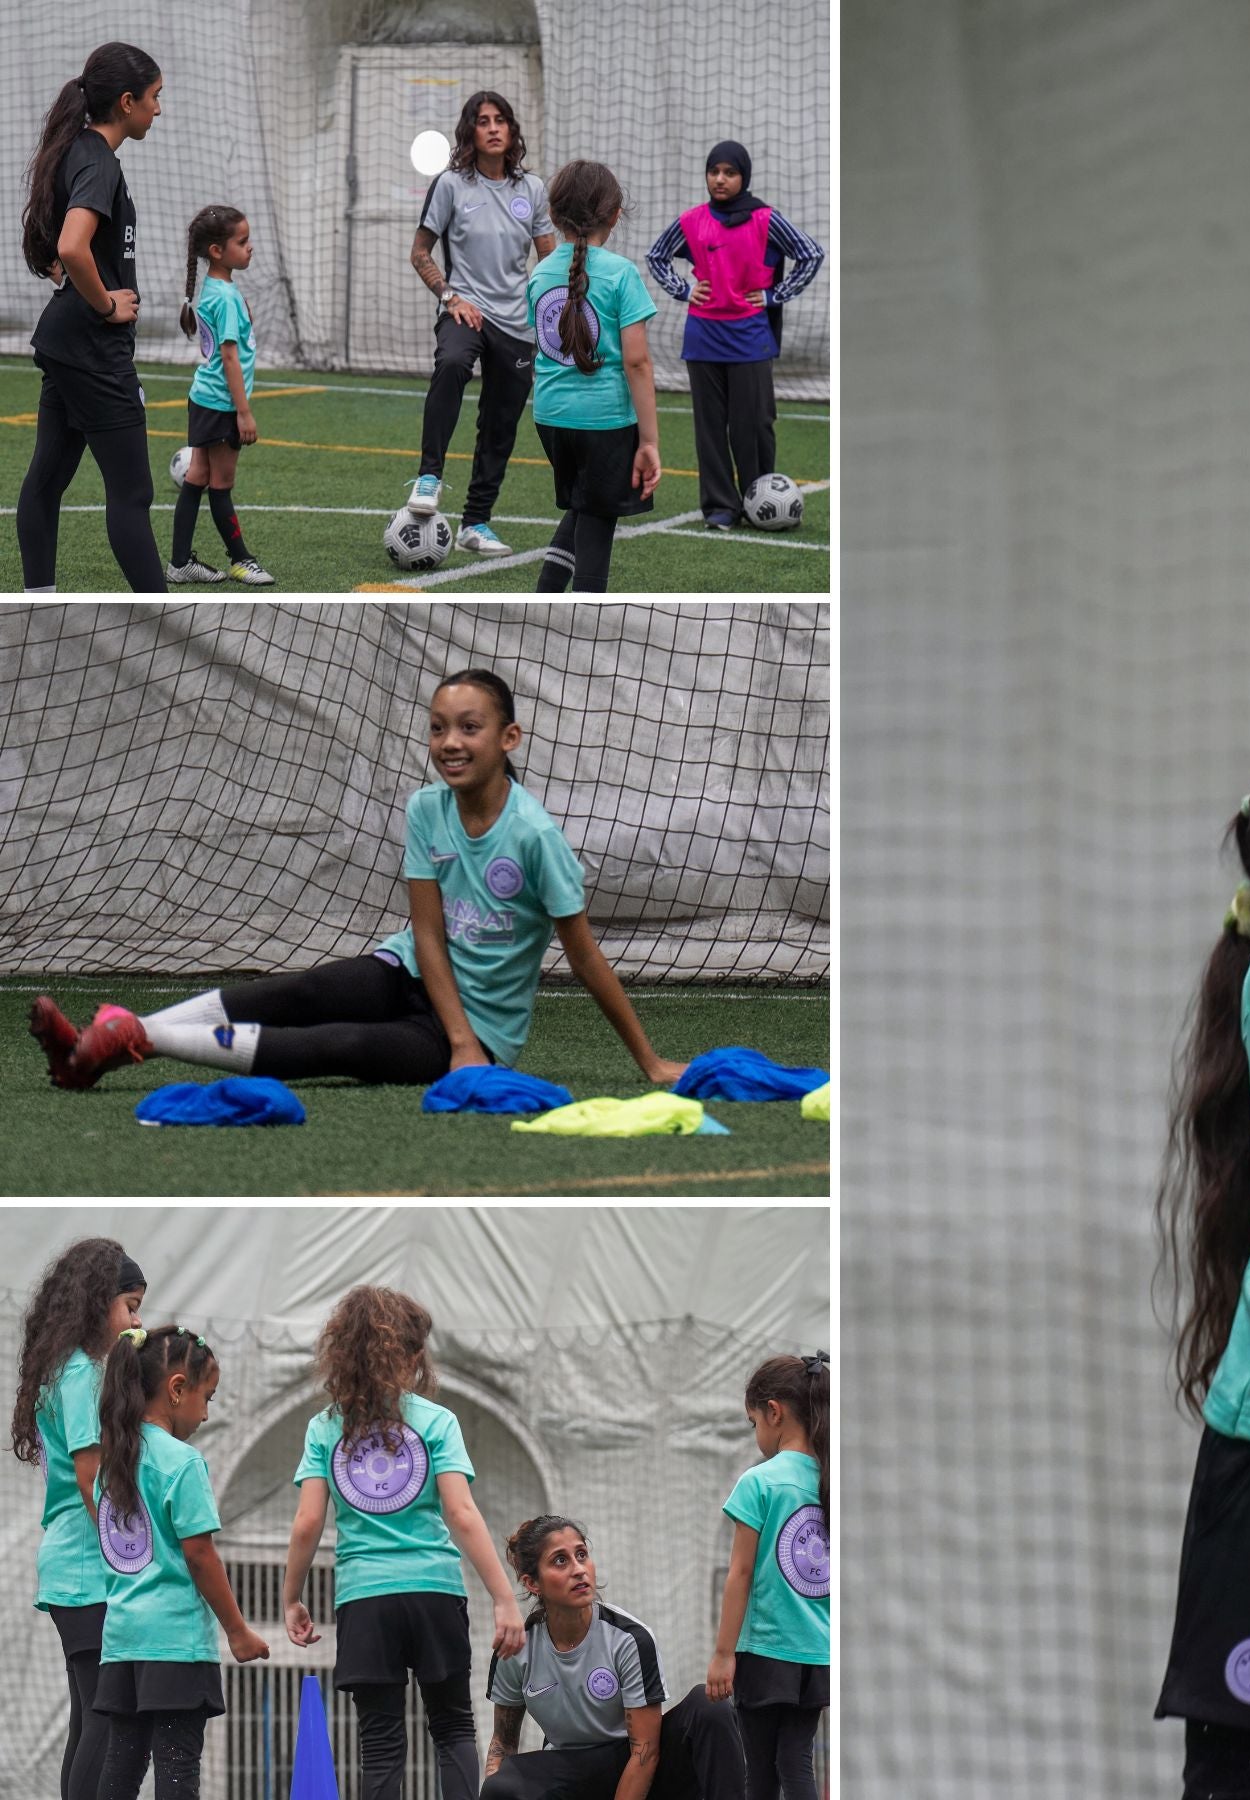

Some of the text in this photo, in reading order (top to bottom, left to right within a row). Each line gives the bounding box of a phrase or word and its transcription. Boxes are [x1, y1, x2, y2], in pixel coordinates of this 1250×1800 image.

[375, 1482, 389, 1492] FC
[125, 1543, 136, 1552] FC
[810, 1567, 822, 1576] FC
